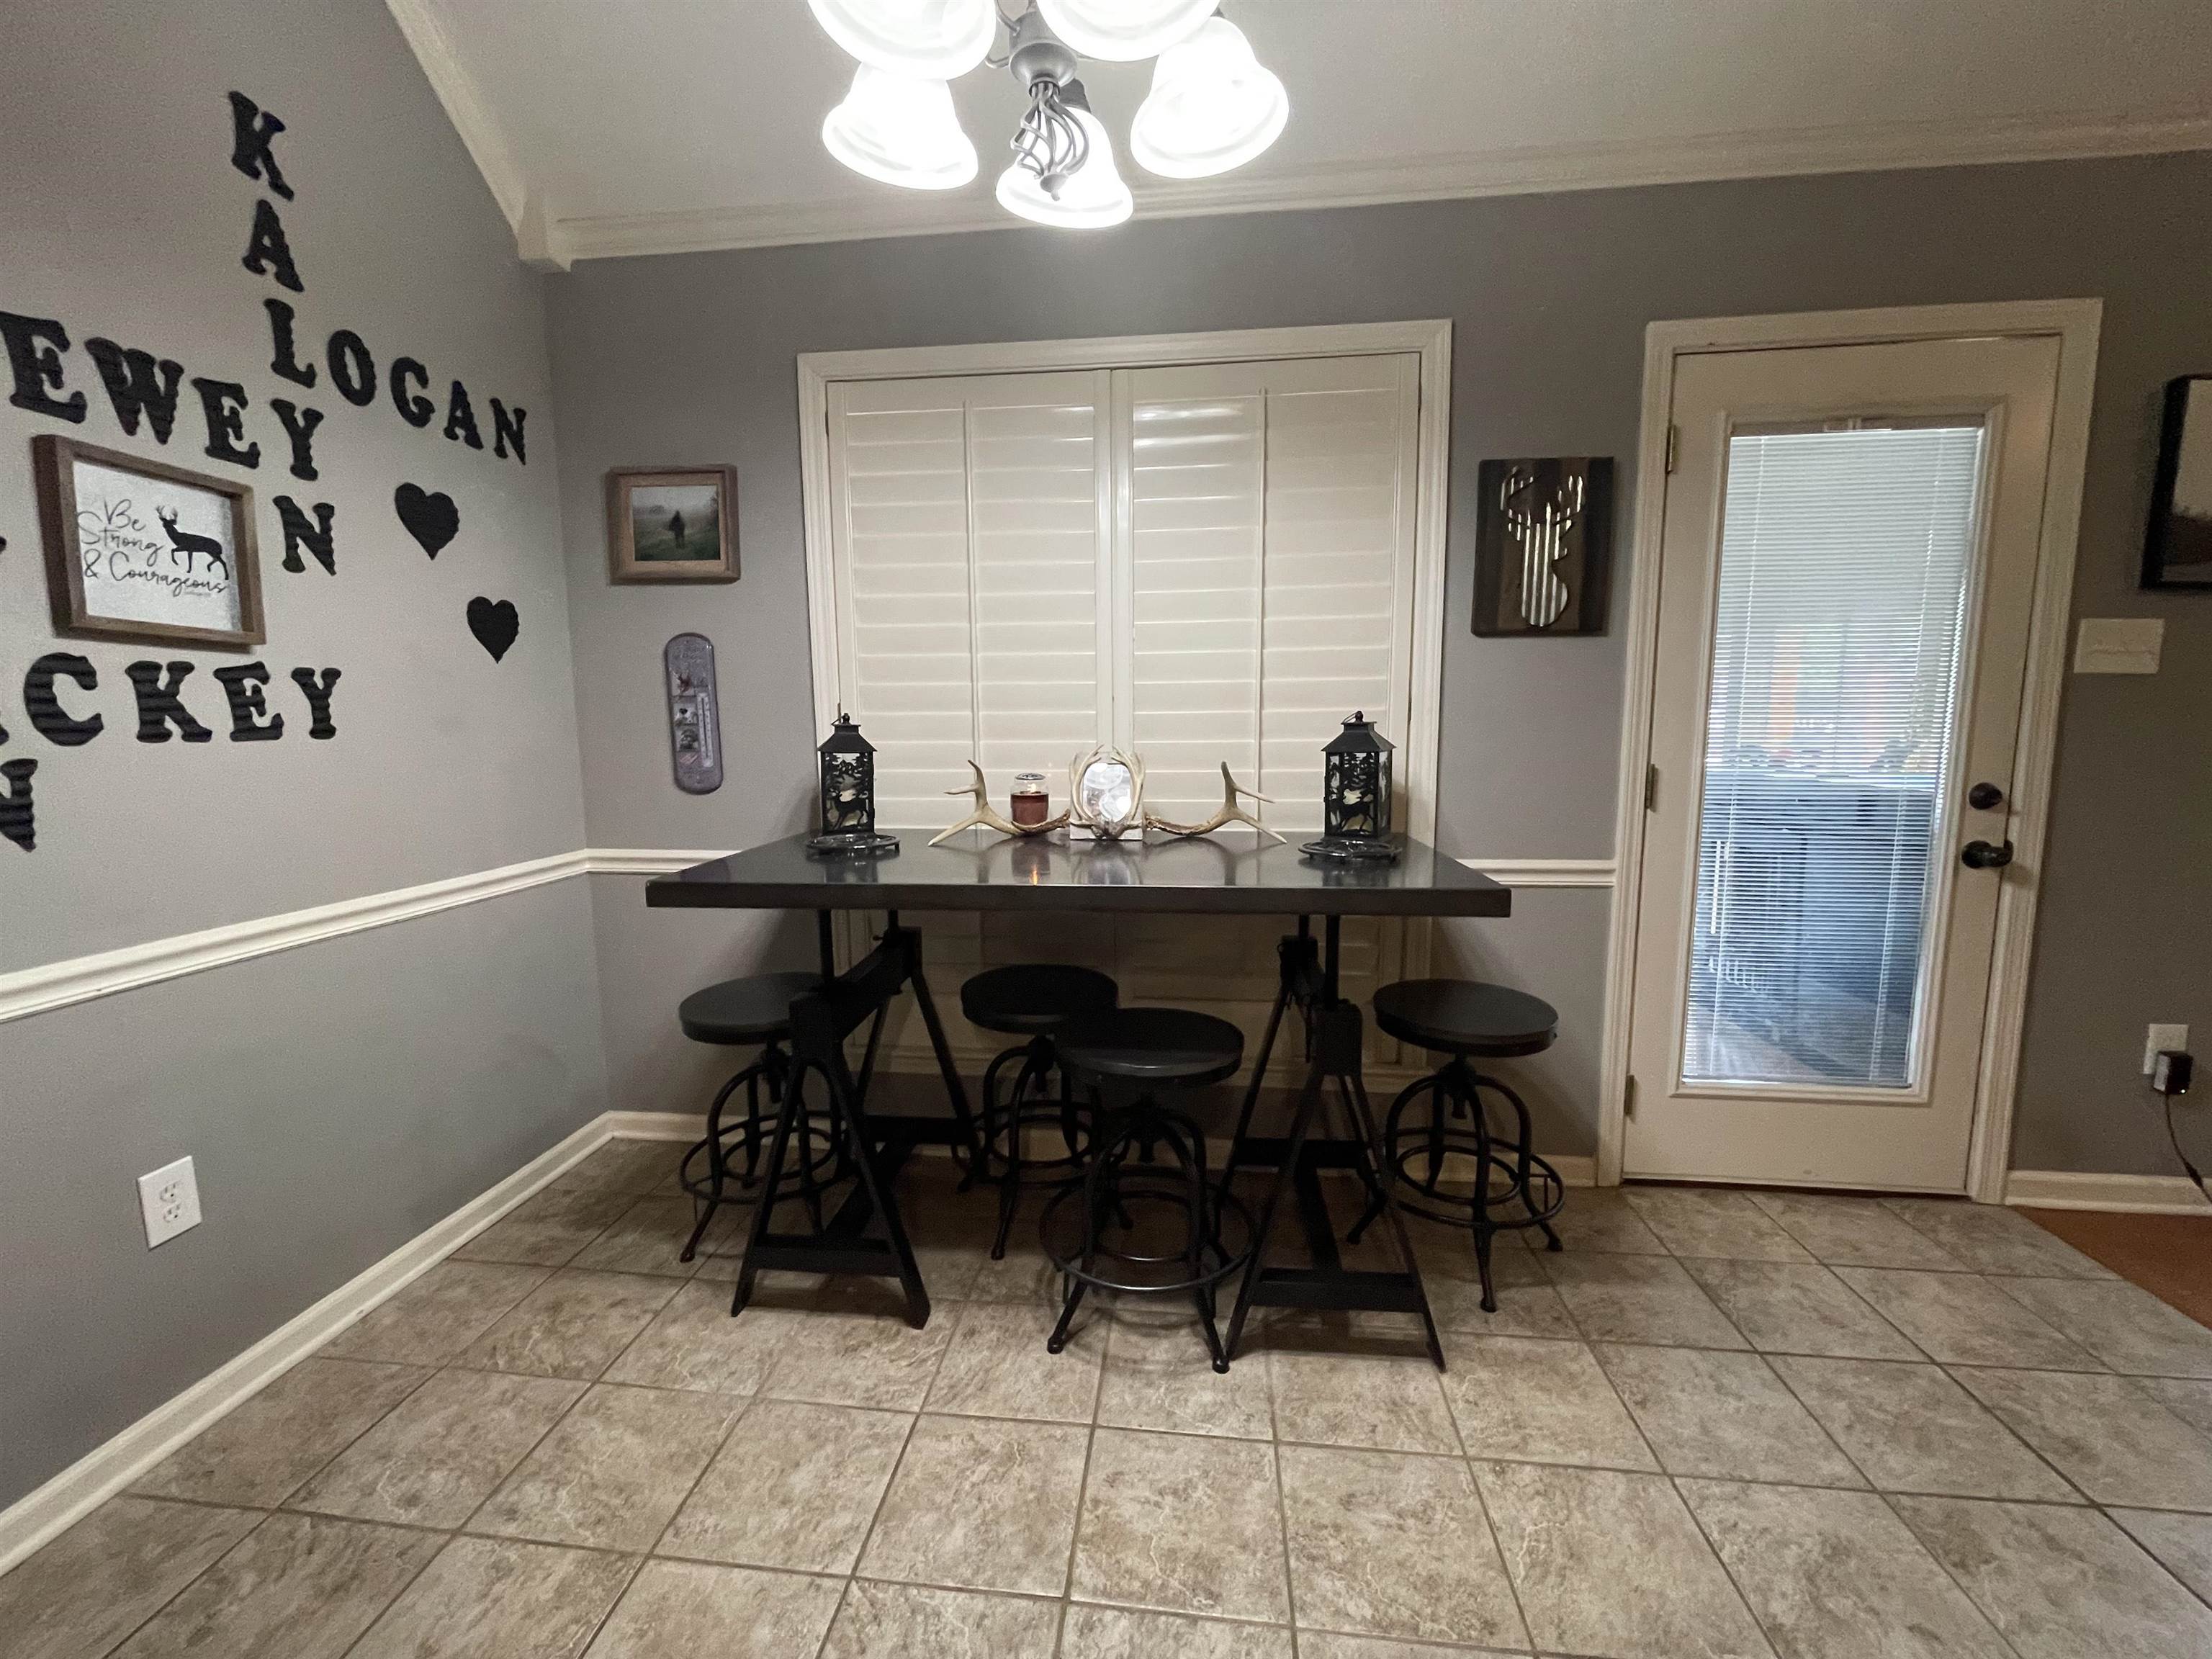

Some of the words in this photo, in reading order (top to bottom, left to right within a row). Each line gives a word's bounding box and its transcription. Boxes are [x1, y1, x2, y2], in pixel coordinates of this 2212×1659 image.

[228, 90, 337, 576] KALYN
[263, 297, 528, 466] LOGAN
[77, 511, 165, 567] Strong
[104, 498, 145, 531] Be
[84, 549, 102, 579] &
[109, 551, 228, 598] Courageous
[0, 652, 342, 747] CKEY
